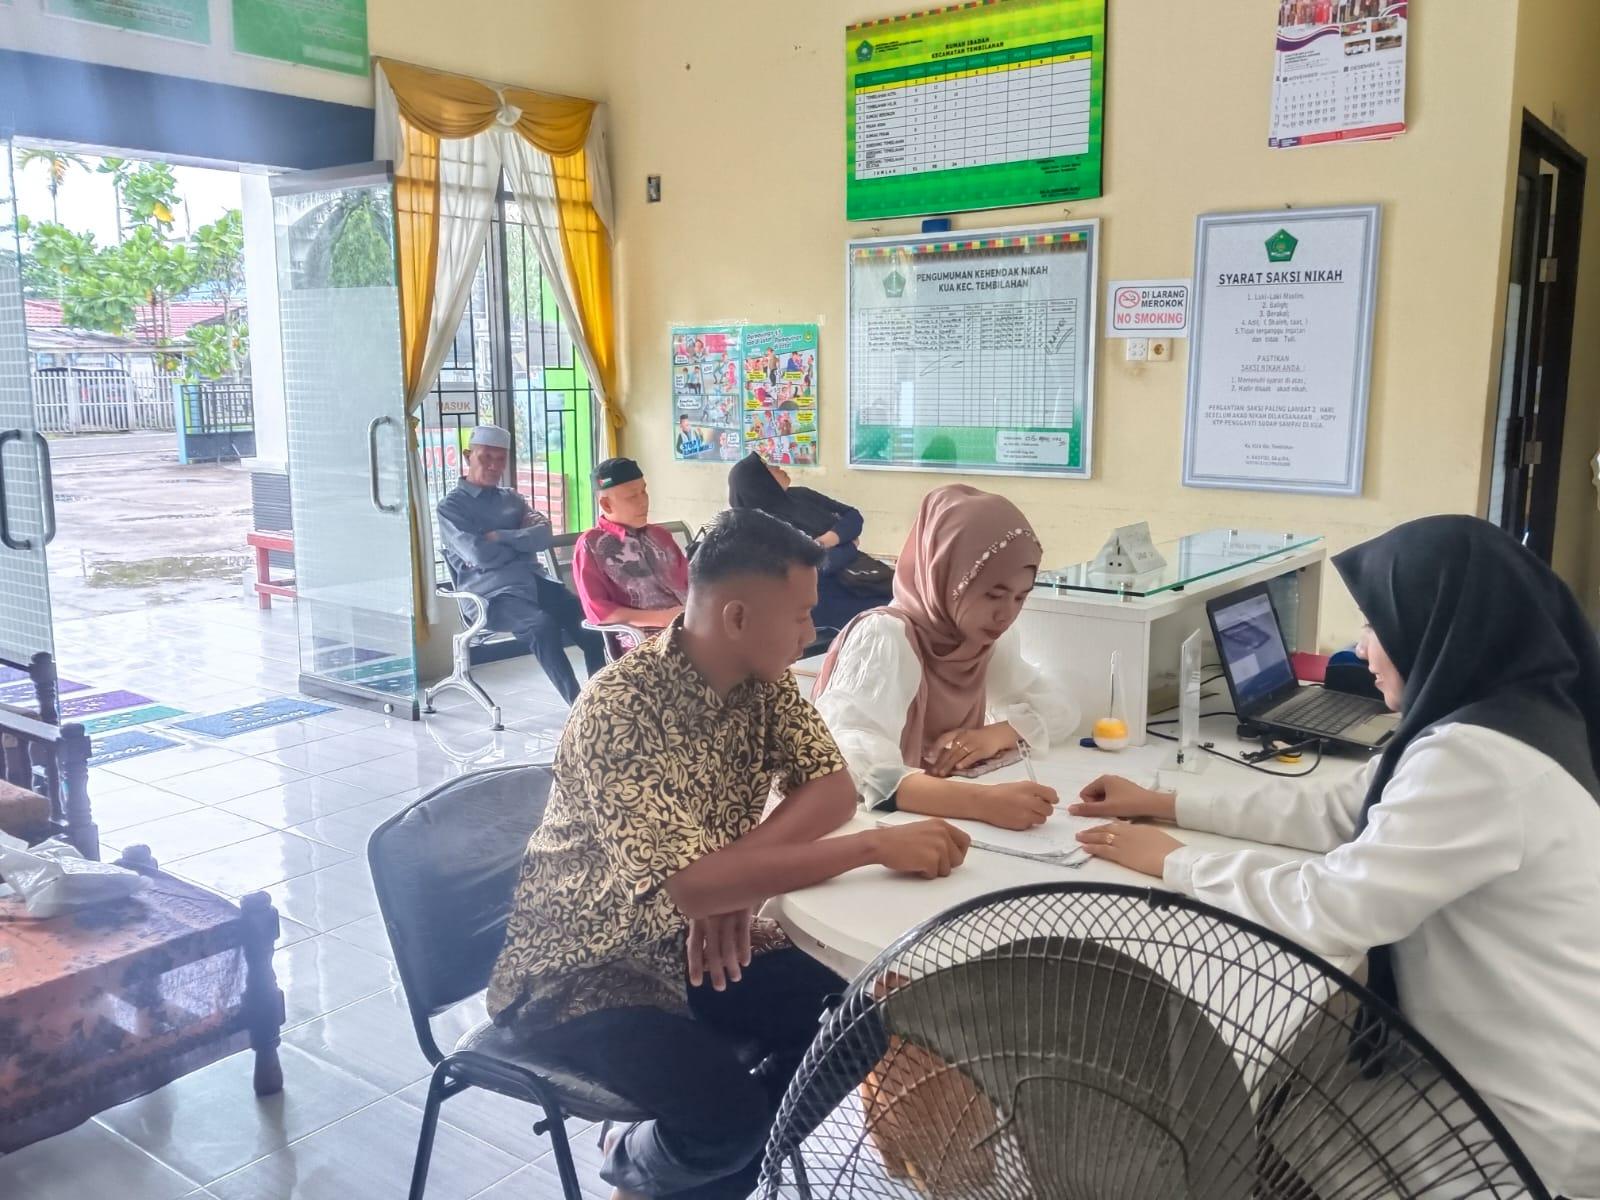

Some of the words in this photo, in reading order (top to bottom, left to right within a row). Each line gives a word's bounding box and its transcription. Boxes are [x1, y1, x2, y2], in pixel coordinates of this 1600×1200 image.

[945, 41, 966, 49] RUMAH
[967, 37, 990, 46] IBADAH
[931, 48, 965, 59] KECAMATAN
[966, 41, 1004, 53] TEMBILAHAN
[916, 270, 973, 282] PENGUMUMAN
[974, 267, 1020, 279] KEHENDAK
[1021, 265, 1049, 276] NIKAH
[1218, 272, 1263, 285] SYARAT
[1266, 271, 1301, 283] SAKSI
[1304, 269, 1343, 282] NIKAH
[938, 283, 955, 293] KUA
[956, 281, 974, 292] KEC.
[975, 279, 1029, 291] TEMBILAHAN
[1141, 291, 1150, 299] DI
[1152, 290, 1185, 299] LARANG
[1141, 299, 1184, 308] MEROKOK
[1116, 313, 1131, 324] NO
[1134, 312, 1183, 324] SMOKING
[1257, 354, 1289, 362] PASTIKAN
[1240, 364, 1259, 372] SAKSI
[1260, 364, 1280, 372] NIKAH
[1246, 404, 1264, 412] SAKSI
[1265, 404, 1286, 413] PALING
[1267, 412, 1313, 421] DILAKSANAKAN
[1224, 419, 1257, 427] PENGGANTI
[1258, 419, 1278, 427] SUDAH
